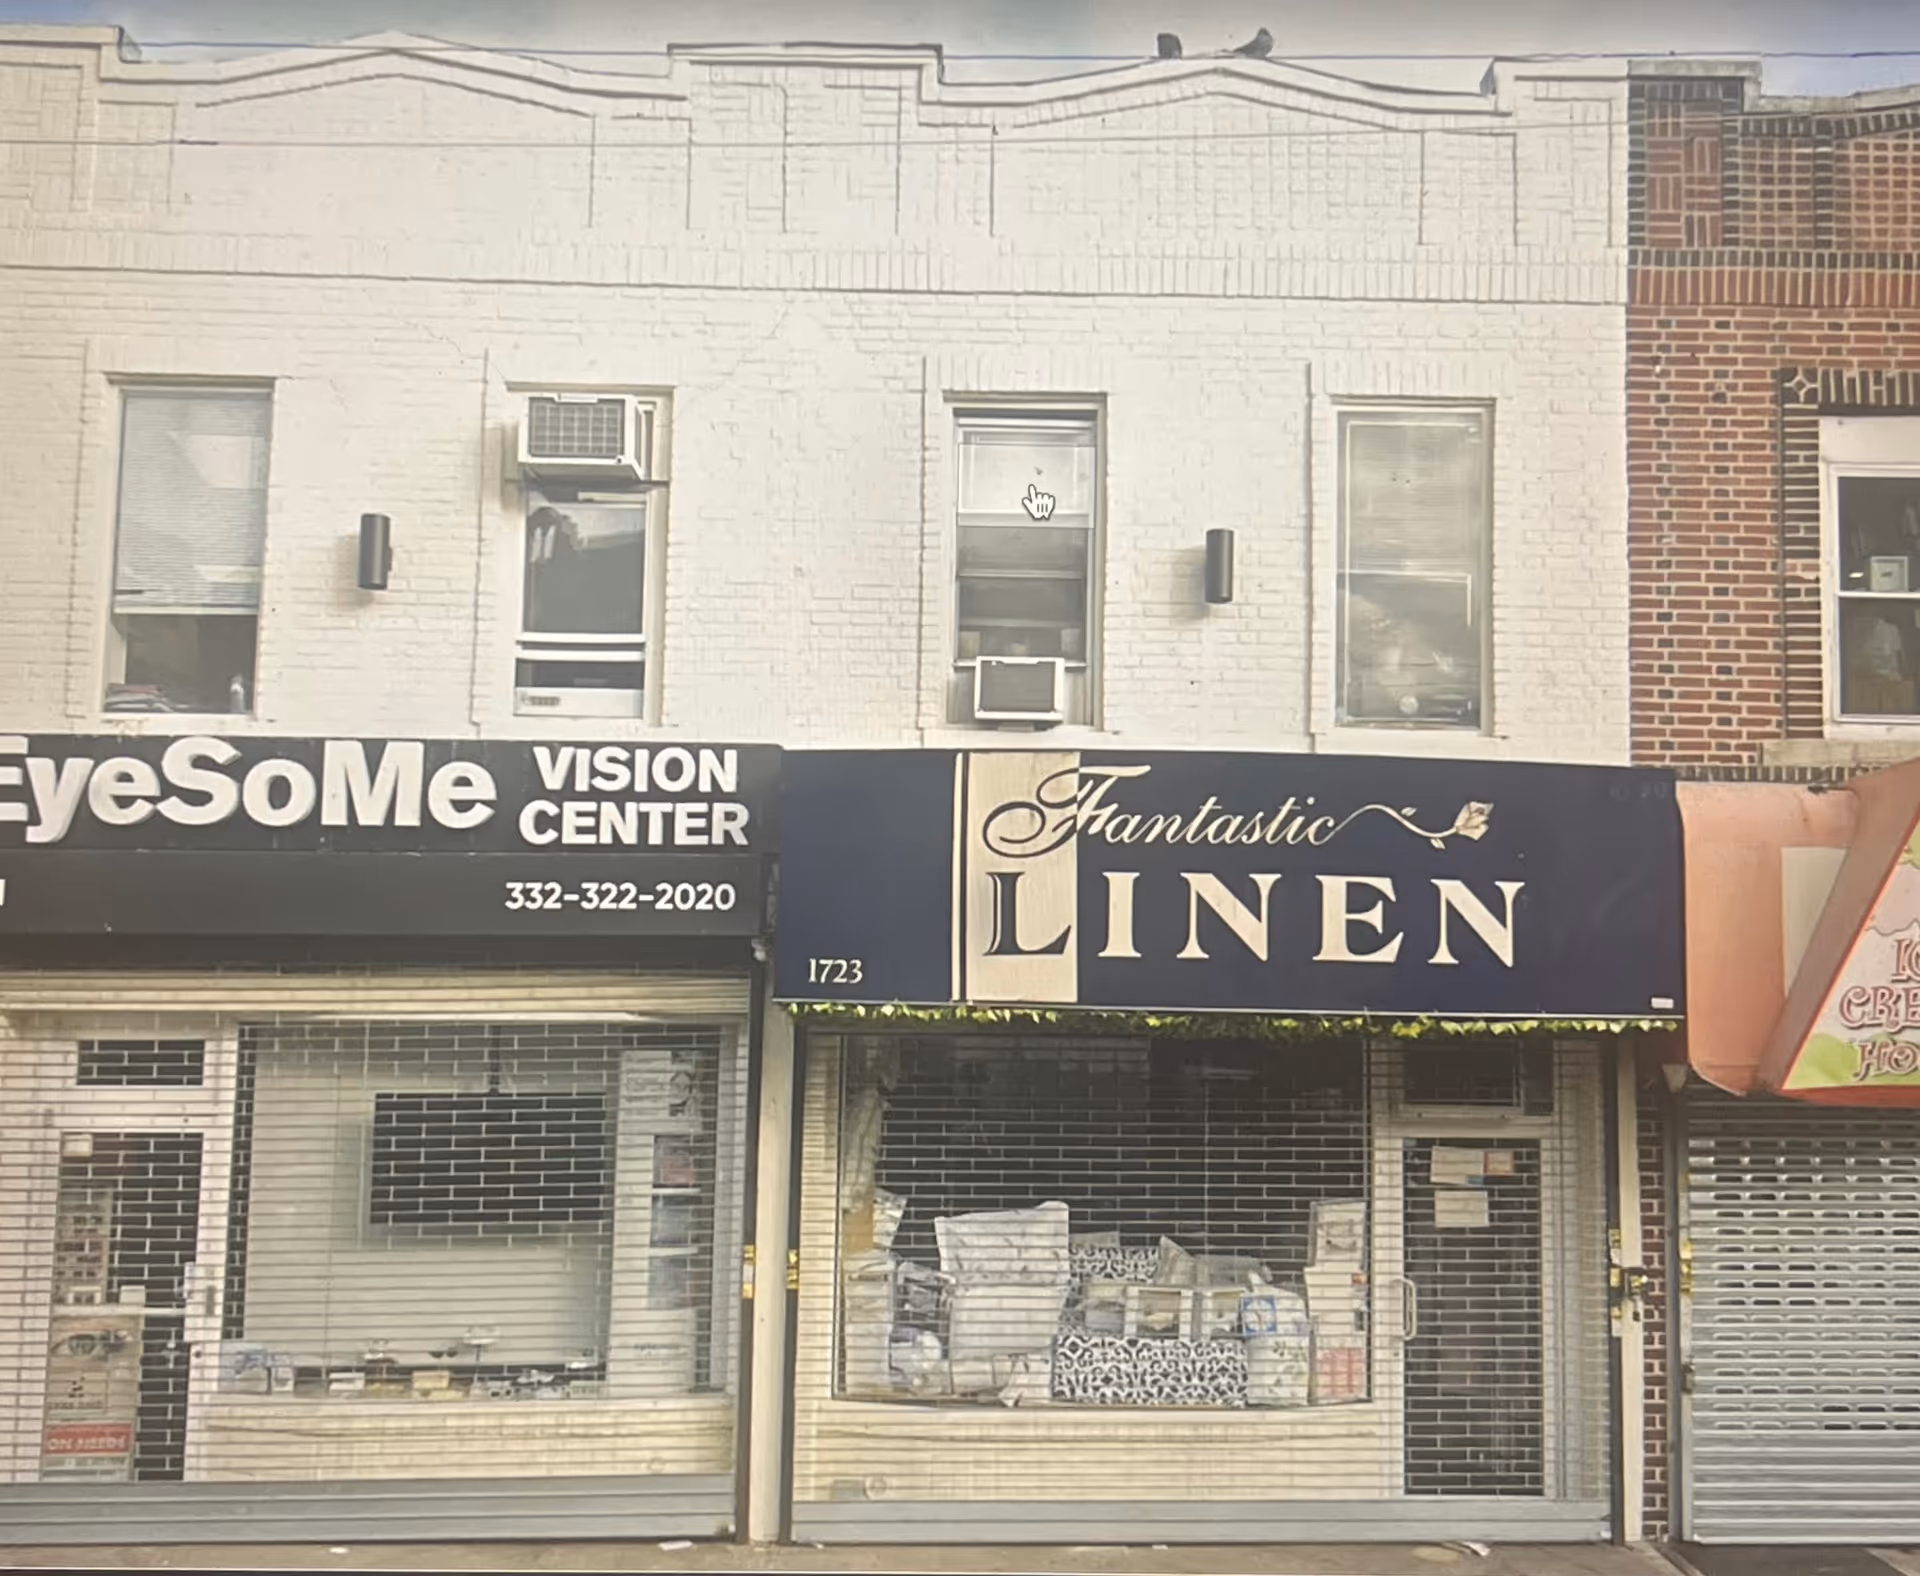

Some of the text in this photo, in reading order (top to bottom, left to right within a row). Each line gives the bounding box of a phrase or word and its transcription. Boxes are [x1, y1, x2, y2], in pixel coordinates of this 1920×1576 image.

[533, 745, 738, 793] VISION
[518, 799, 750, 846] CENTER
[982, 765, 1338, 859] Fantastic
[505, 881, 736, 911] 332-322-2020
[983, 871, 1526, 968] LINEN
[808, 958, 864, 984] 1723
